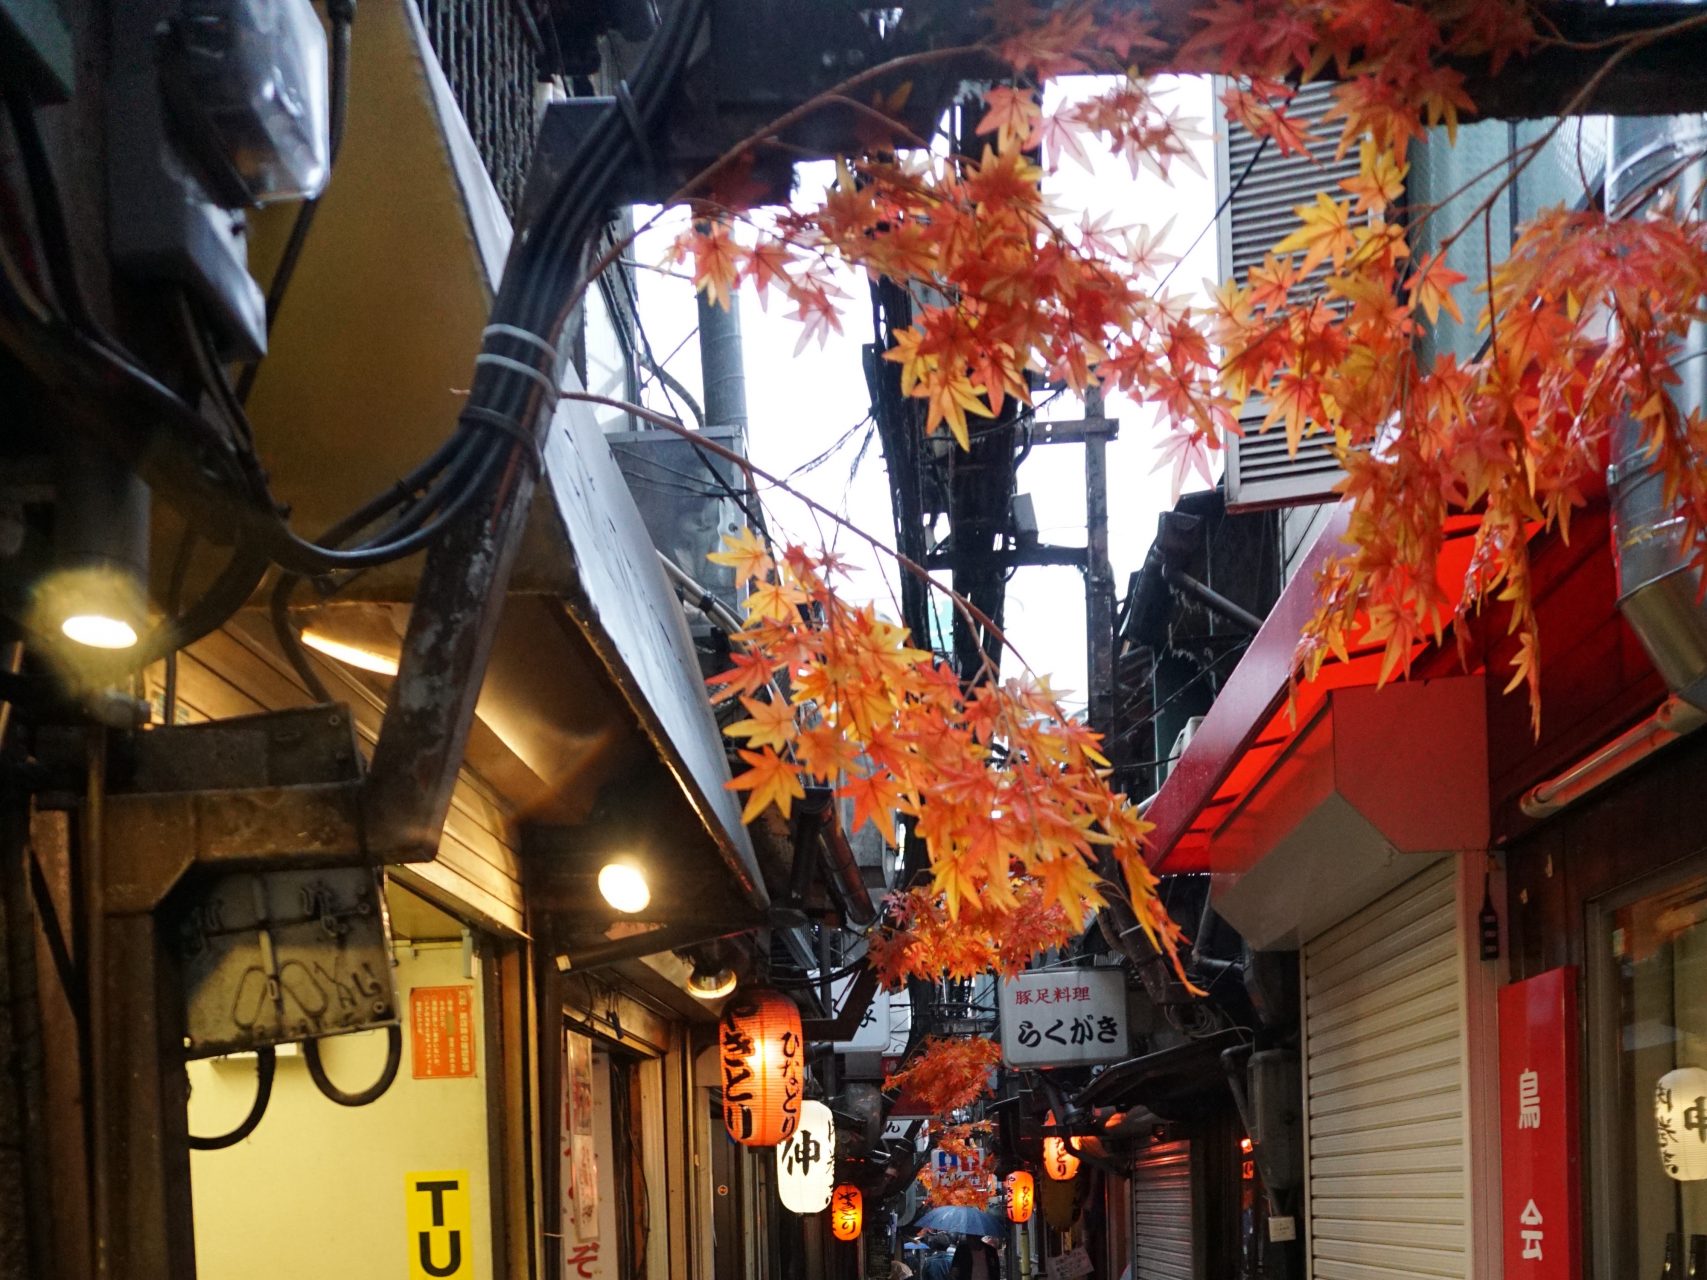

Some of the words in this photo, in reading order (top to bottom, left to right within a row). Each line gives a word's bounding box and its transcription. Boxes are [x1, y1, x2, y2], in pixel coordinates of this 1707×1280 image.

[1015, 986, 1091, 1005] 豚足料理
[1018, 1014, 1119, 1048] らくがき
[723, 1000, 762, 1140] やきとり
[776, 1031, 800, 1139] ひなどり
